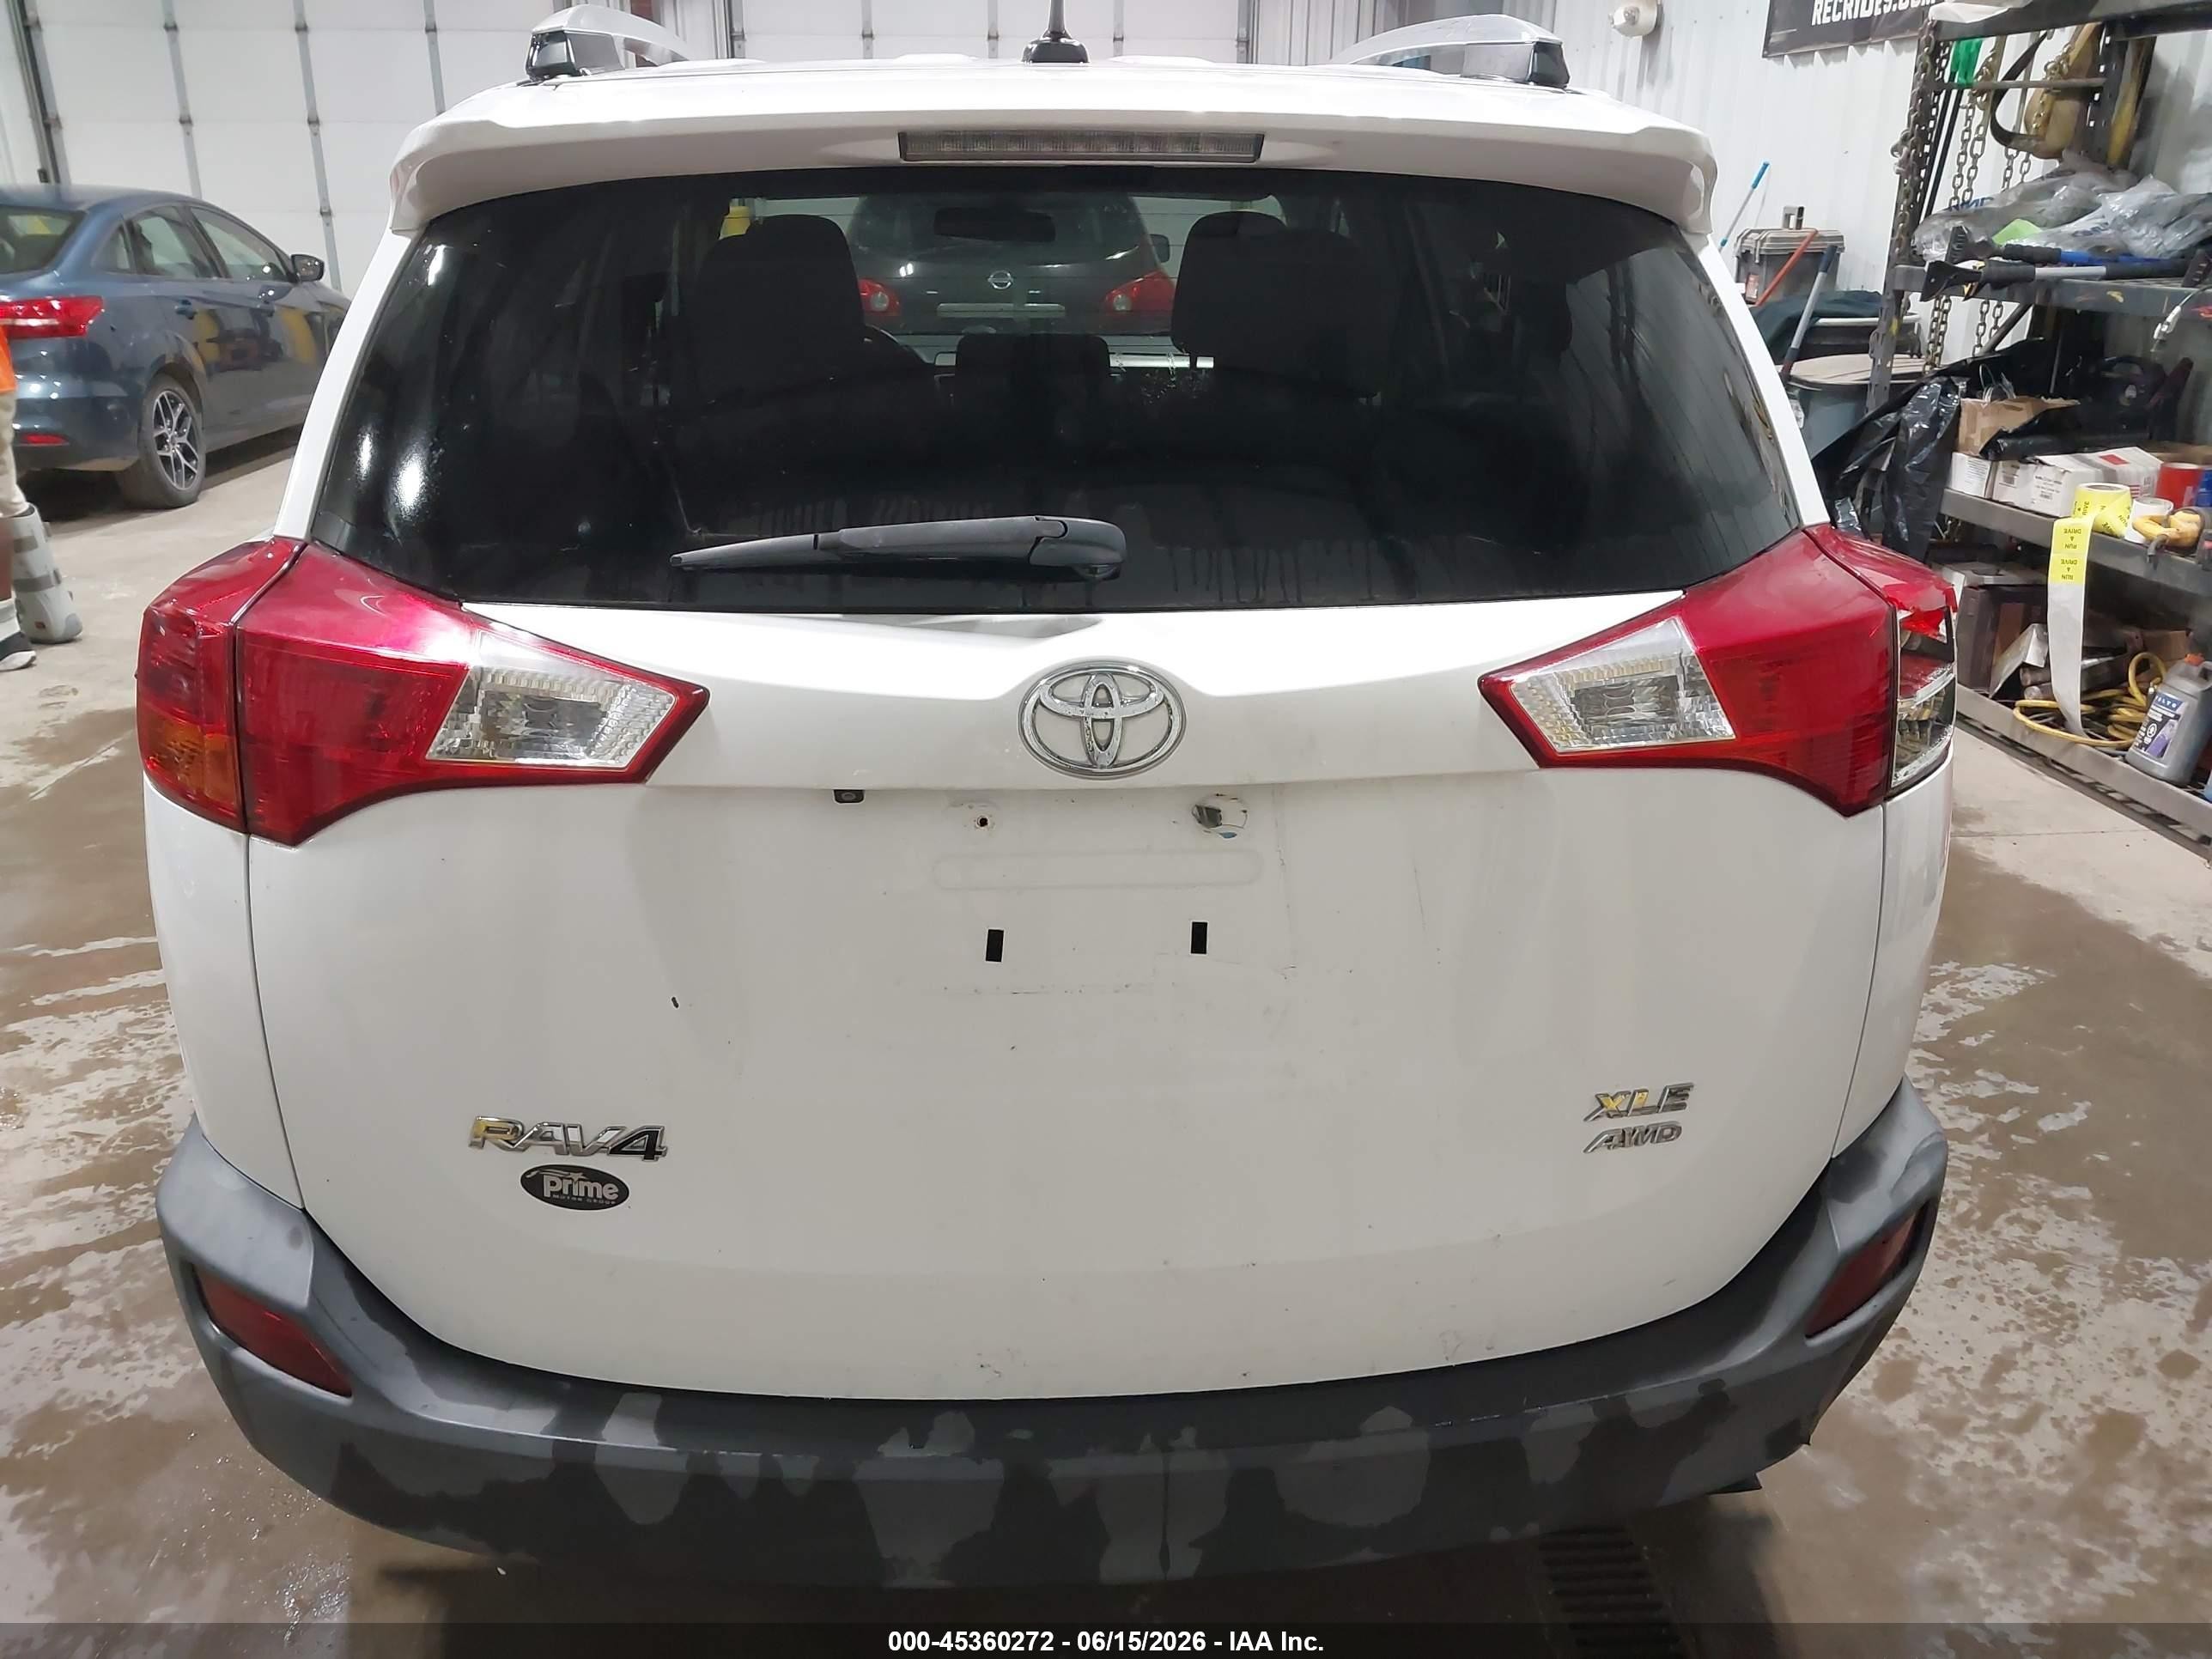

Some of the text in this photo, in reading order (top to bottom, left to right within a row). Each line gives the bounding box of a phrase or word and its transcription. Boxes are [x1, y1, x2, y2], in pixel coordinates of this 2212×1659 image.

[1812, 0, 1935, 26] RECRIDES.
[1583, 1082, 1694, 1121] XLE
[468, 1115, 668, 1162] RAV4
[1583, 1121, 1683, 1154] AWD
